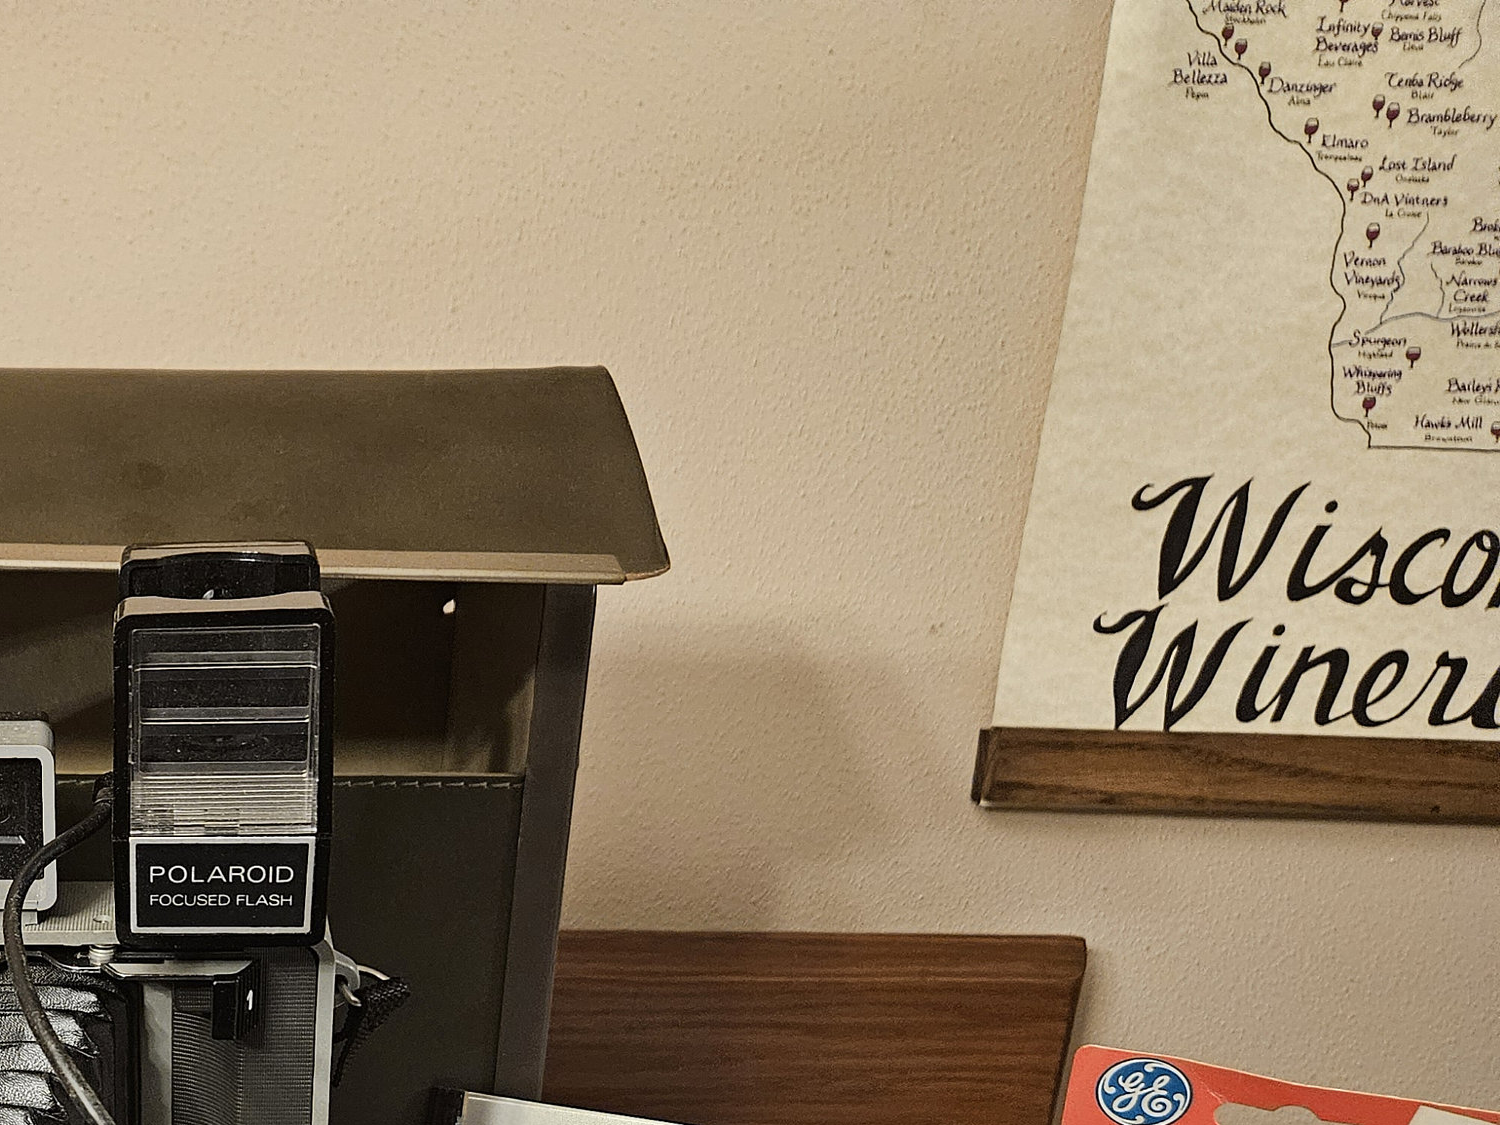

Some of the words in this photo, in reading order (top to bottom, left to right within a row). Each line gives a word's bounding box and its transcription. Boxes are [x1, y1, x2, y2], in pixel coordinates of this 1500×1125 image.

[1316, 16, 1370, 37] Infinity
[1427, 26, 1462, 48] Bluff
[1315, 36, 1378, 58] Beverages
[1187, 51, 1218, 66] Villa
[1171, 69, 1228, 85] Bellezza
[1427, 72, 1464, 91] Ridge
[1267, 76, 1336, 98] Danzinger
[1407, 105, 1498, 130] Brambleberry
[1321, 135, 1369, 149] Elmaro
[1379, 154, 1407, 171] Lost
[1412, 154, 1457, 171] Island
[1360, 191, 1390, 205] DnA
[1394, 192, 1448, 207] Vintners
[1343, 251, 1387, 268] Vernon
[1344, 270, 1400, 288] Vineyards
[1446, 271, 1497, 287] Narrows
[1453, 289, 1489, 303] Creek
[1349, 329, 1407, 348] Spurgeon
[1343, 364, 1403, 380] Whispering
[1131, 474, 1500, 611] Wisco
[149, 865, 295, 884] POLAROID
[149, 893, 231, 907] FOCUSED
[236, 893, 294, 907] FLASH
